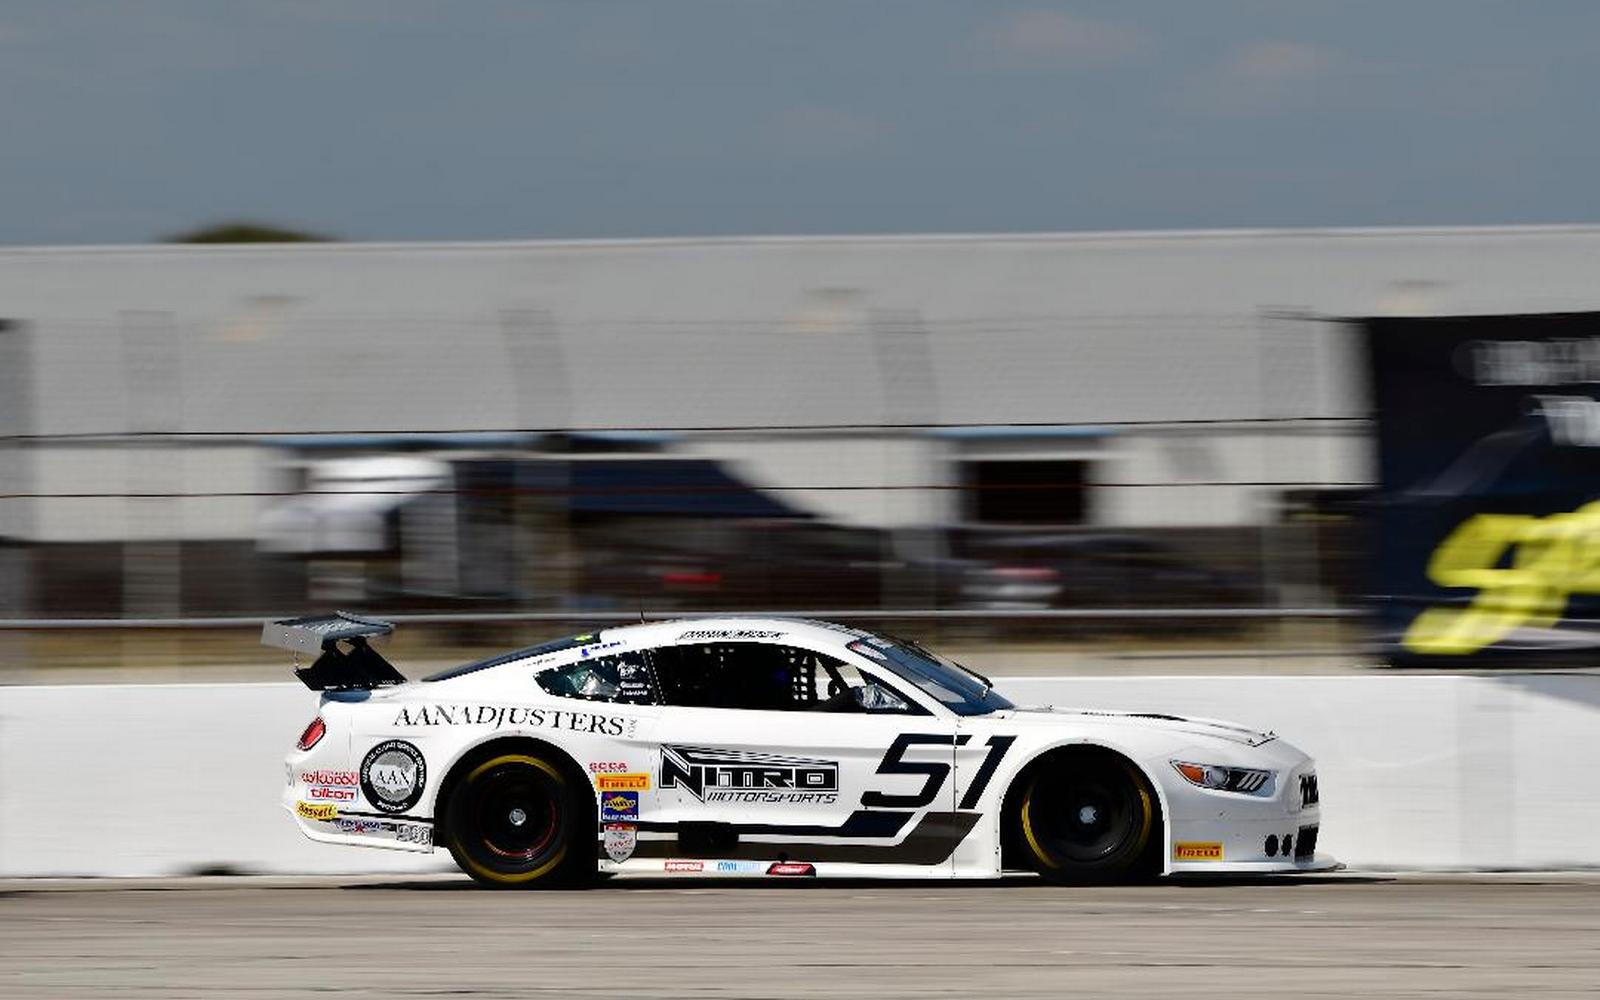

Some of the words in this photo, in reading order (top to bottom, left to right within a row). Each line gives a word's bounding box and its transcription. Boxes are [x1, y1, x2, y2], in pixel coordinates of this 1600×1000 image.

[393, 705, 624, 736] AANADJUSTERS
[658, 744, 839, 804] NITRO
[859, 733, 1018, 809] 51
[706, 791, 838, 804] MOTORSPORTS
